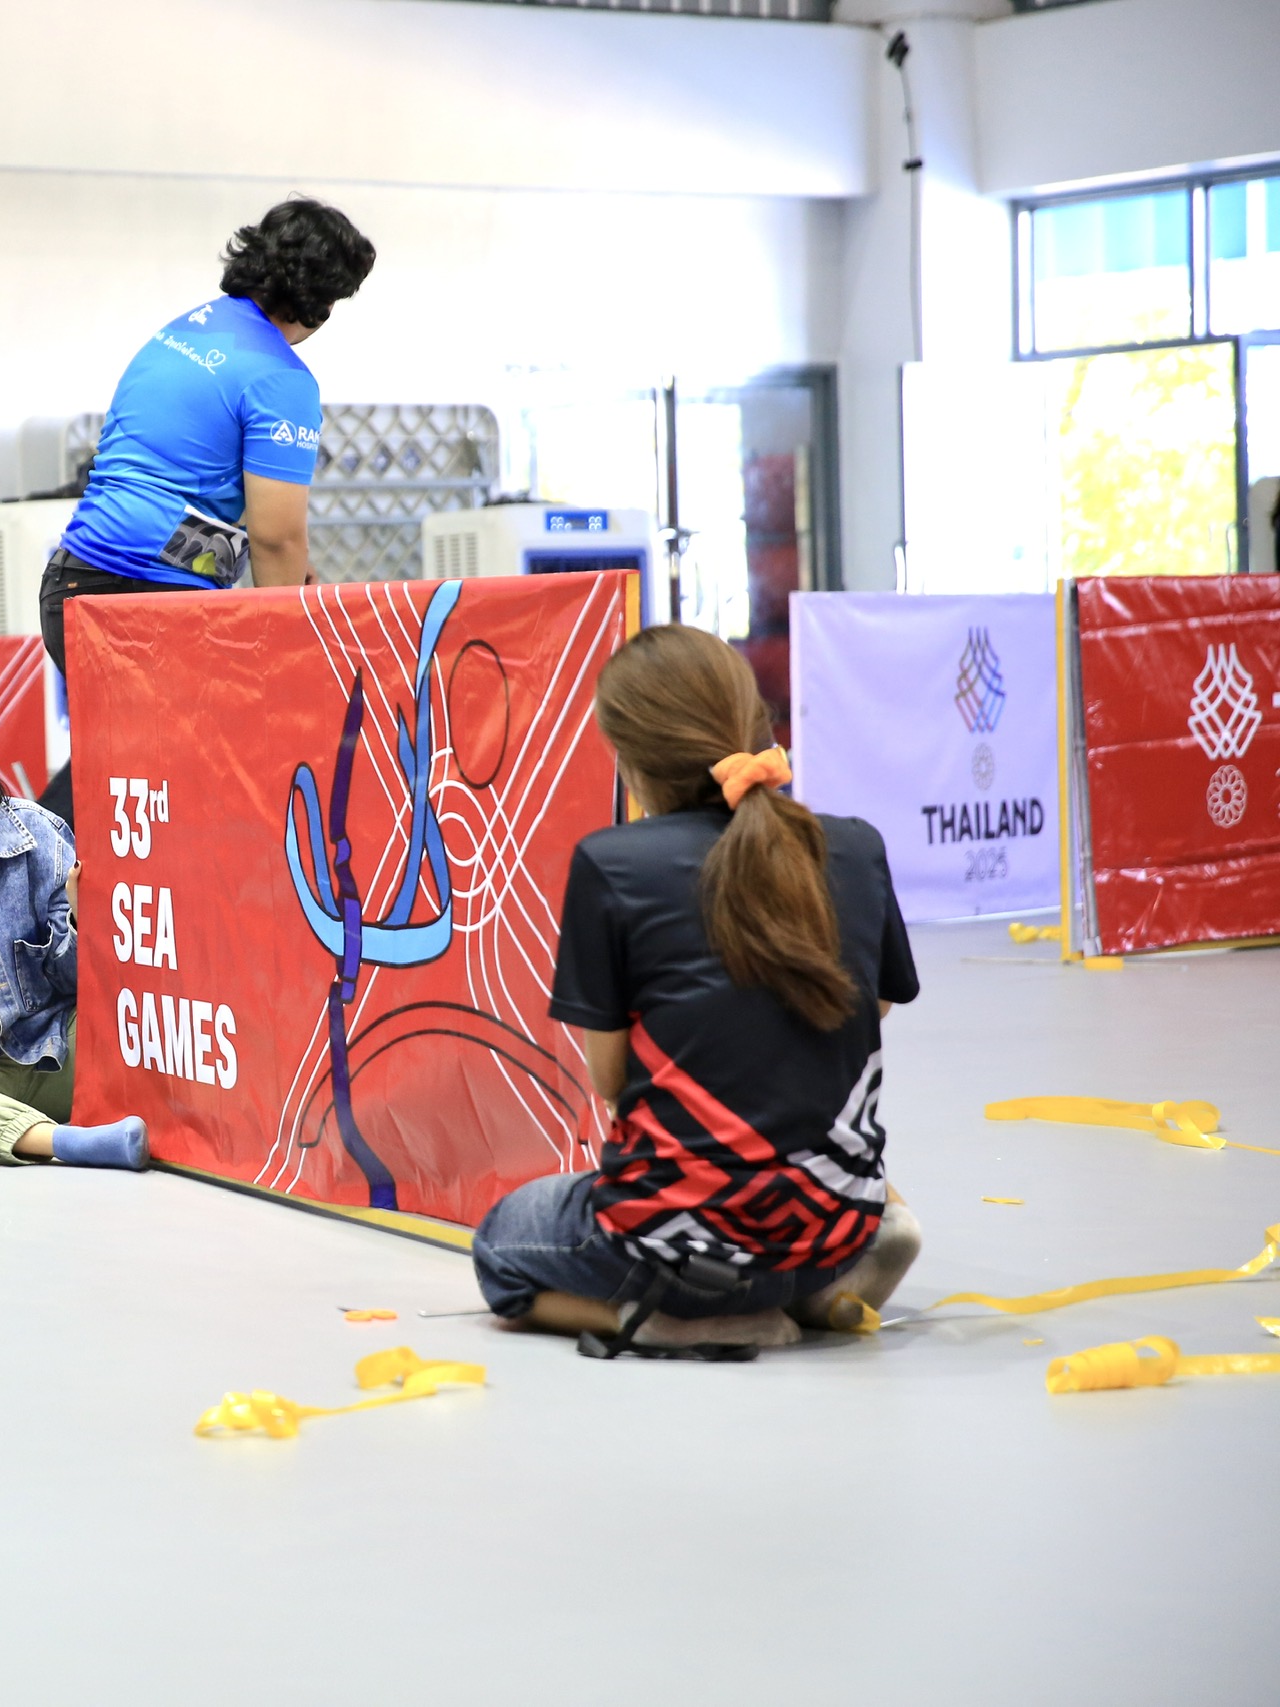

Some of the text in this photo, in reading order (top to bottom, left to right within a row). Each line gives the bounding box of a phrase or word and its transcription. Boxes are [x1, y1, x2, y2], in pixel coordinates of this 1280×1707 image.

[109, 776, 170, 860] 33rd
[921, 797, 1045, 845] THAILAND
[964, 846, 1008, 882] 2025
[111, 881, 178, 971] SEA
[117, 986, 238, 1090] GAMES
